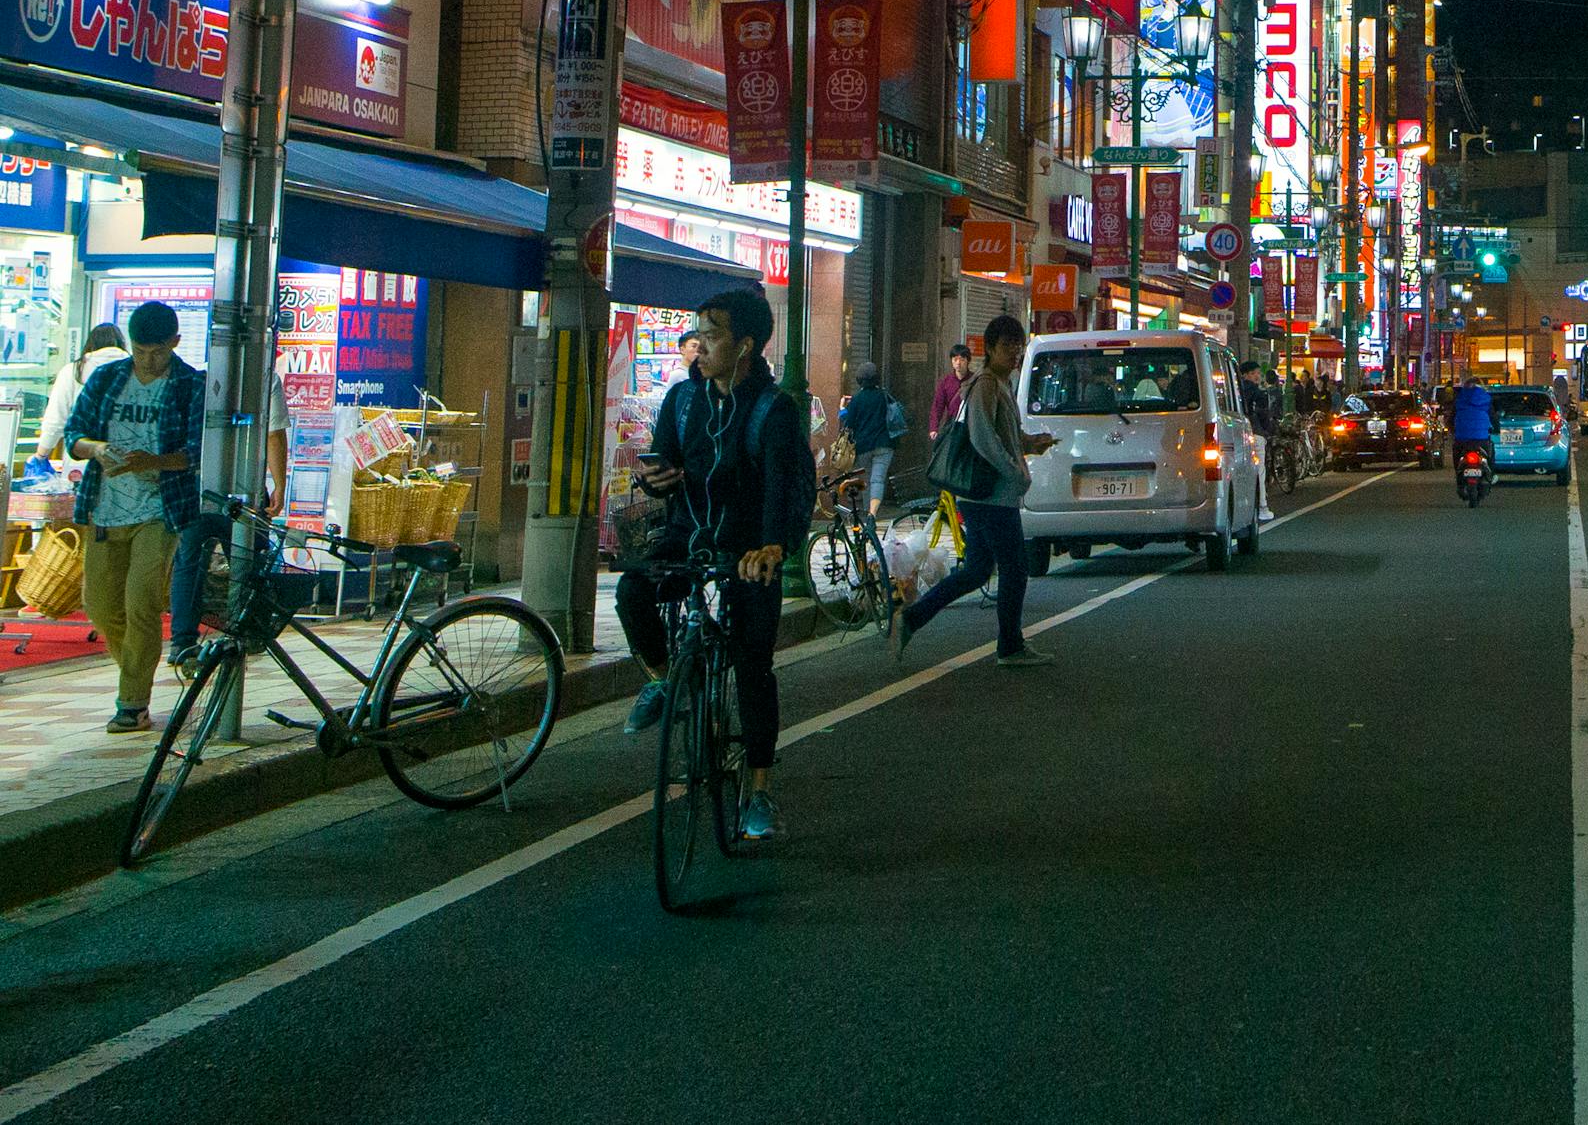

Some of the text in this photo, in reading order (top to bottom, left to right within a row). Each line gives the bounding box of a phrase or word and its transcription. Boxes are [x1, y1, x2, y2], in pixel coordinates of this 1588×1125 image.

[299, 85, 400, 126] JANPARA OSAKA01
[671, 113, 704, 144] ROLEX
[968, 235, 1005, 253] au
[1213, 234, 1235, 252] 40
[1037, 274, 1068, 295] au
[300, 310, 336, 333] レンズ
[340, 310, 415, 341] TAX FREE
[286, 350, 331, 375] MAX
[285, 384, 330, 399] SALE
[337, 379, 384, 398] Smartphone
